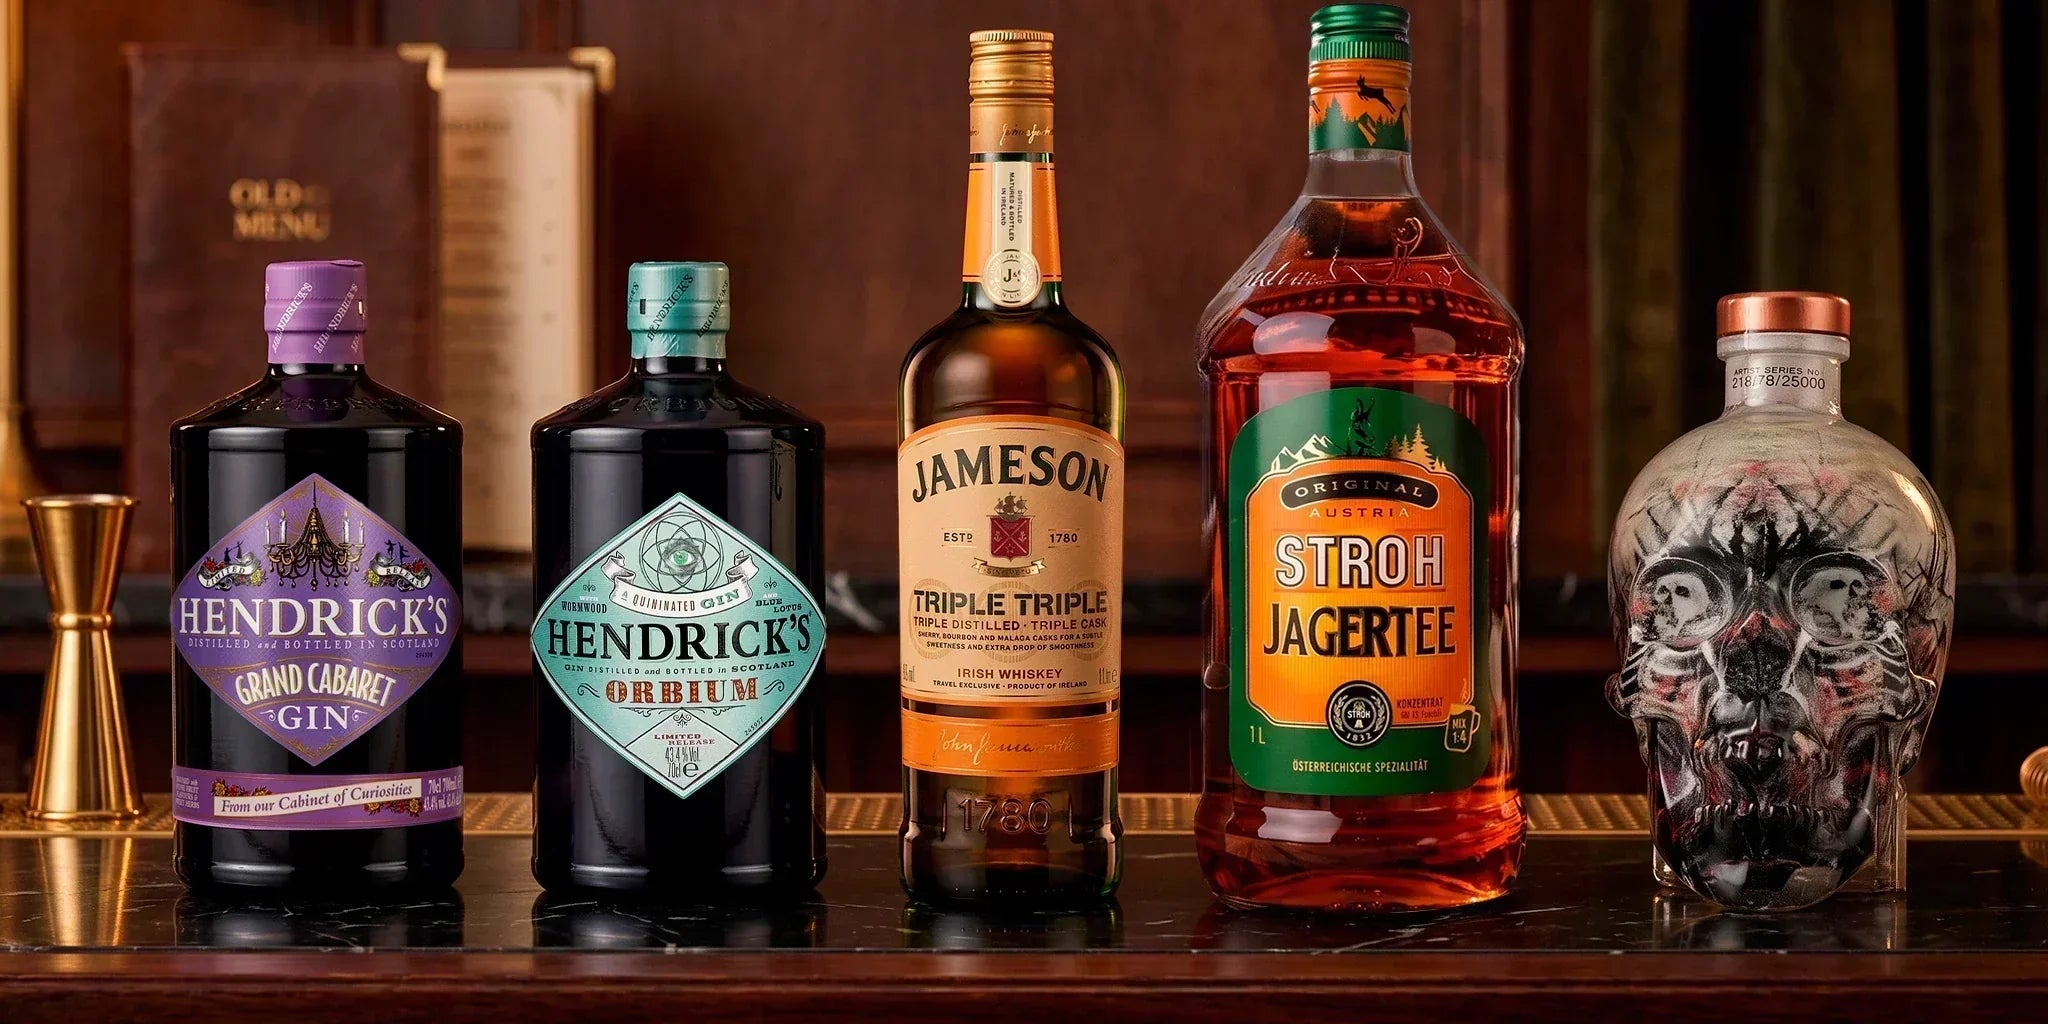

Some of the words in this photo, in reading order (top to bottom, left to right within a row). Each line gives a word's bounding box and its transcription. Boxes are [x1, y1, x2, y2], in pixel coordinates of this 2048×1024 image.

[1734, 367, 1759, 376] ARTIST
[1764, 366, 1803, 374] SERIES
[1732, 374, 1826, 390] 218/78/25000
[912, 444, 1110, 503] JAMESON
[1295, 479, 1423, 498] ORIGINAL
[1308, 507, 1409, 518] AUSTRIA
[1049, 532, 1078, 544] 1780
[1274, 534, 1445, 589] STROH
[205, 566, 246, 587] LIMITED
[386, 568, 426, 587] RELEASE
[561, 601, 608, 614] WORMWOOD
[622, 590, 628, 600] A
[633, 594, 696, 612] QUININATED
[700, 588, 740, 610] GIN
[755, 598, 783, 607] BLUE
[914, 589, 1005, 616] TRIPLE
[1014, 590, 1107, 616] TRIPLE
[179, 595, 450, 637] HENDRICK'S
[773, 603, 803, 614] LOTUS
[914, 617, 948, 629] TRIPLE
[952, 619, 1020, 631] DISTILLED
[1031, 620, 1077, 630] TRIPLE
[1080, 617, 1107, 629] CASK
[1263, 602, 1456, 658] JAGERTEE
[188, 638, 250, 649] DISTILLED
[257, 640, 278, 650] and
[284, 640, 352, 650] BOTTLED
[360, 640, 375, 649] IN
[382, 638, 440, 649] SCOTLAND
[547, 613, 812, 661] HENDRICK'S
[918, 631, 942, 640] SHERRY,
[942, 633, 977, 641] BOURBON
[1032, 634, 1058, 642] CASKS
[1082, 631, 1103, 640] SUBTLE
[926, 640, 966, 650] SWEETNESS
[1049, 642, 1094, 650] SMOOTHNESS
[564, 664, 584, 672] GIN
[588, 666, 641, 676] DISTILLED
[644, 667, 661, 676] and
[665, 666, 713, 675] BOTTLED
[717, 666, 728, 674] in
[731, 659, 796, 674] SCOTLAND
[957, 668, 994, 679] IRISH
[999, 668, 1063, 680] WHISKEY
[235, 663, 302, 706] GRAND
[307, 662, 397, 708] CABARET
[605, 677, 759, 704] ORBIUM
[933, 679, 958, 688] TRAVEL
[959, 681, 1001, 690] EXCLUSIVE
[1007, 682, 1045, 690] PRODUCT
[1059, 681, 1088, 689] IRELAND
[1396, 697, 1443, 709] KONZENTRAT
[278, 704, 350, 731] GIN
[1347, 710, 1371, 719] STROH
[1452, 718, 1467, 729] MIX
[1258, 728, 1266, 744] L
[1346, 732, 1373, 742] 1832
[1452, 730, 1467, 744] 1:4
[1292, 758, 1371, 773] ÖSTERREICHISCHE
[1375, 759, 1428, 771] SPEZIALITÄT
[220, 799, 250, 813] From
[254, 802, 275, 812] our
[278, 794, 329, 810] Cabinet
[333, 789, 347, 807] of
[350, 784, 413, 803] Curiosities
[958, 797, 1052, 835] 1780
